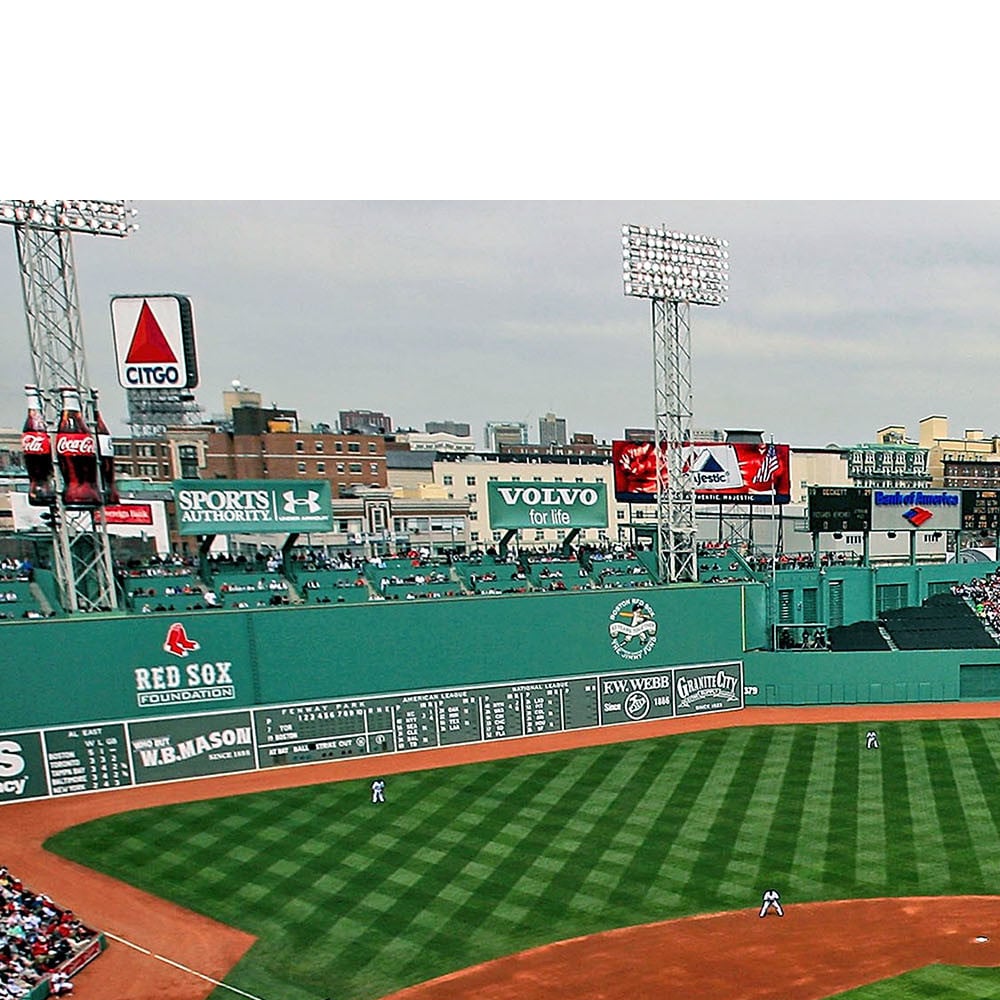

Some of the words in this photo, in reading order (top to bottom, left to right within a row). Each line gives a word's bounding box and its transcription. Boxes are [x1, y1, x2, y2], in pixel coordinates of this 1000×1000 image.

[126, 366, 178, 384] CITGO
[179, 490, 270, 510] SPORTS
[498, 487, 598, 506] VOLVO
[874, 491, 903, 506] Bank
[915, 491, 959, 505] America
[529, 508, 548, 524] for
[550, 508, 570, 524] life
[135, 666, 181, 690] RED
[186, 662, 233, 686] SOX
[630, 676, 670, 690] WEBB
[677, 675, 717, 698] GRANITE
[716, 670, 738, 697] CITY
[141, 688, 232, 704] FOUNDATION
[402, 694, 439, 703] AMERICAN
[441, 691, 467, 699] LEAGUE
[282, 705, 328, 715] FENWAY
[336, 702, 366, 710] PARK
[604, 702, 621, 712] Since
[82, 728, 103, 736] EAST
